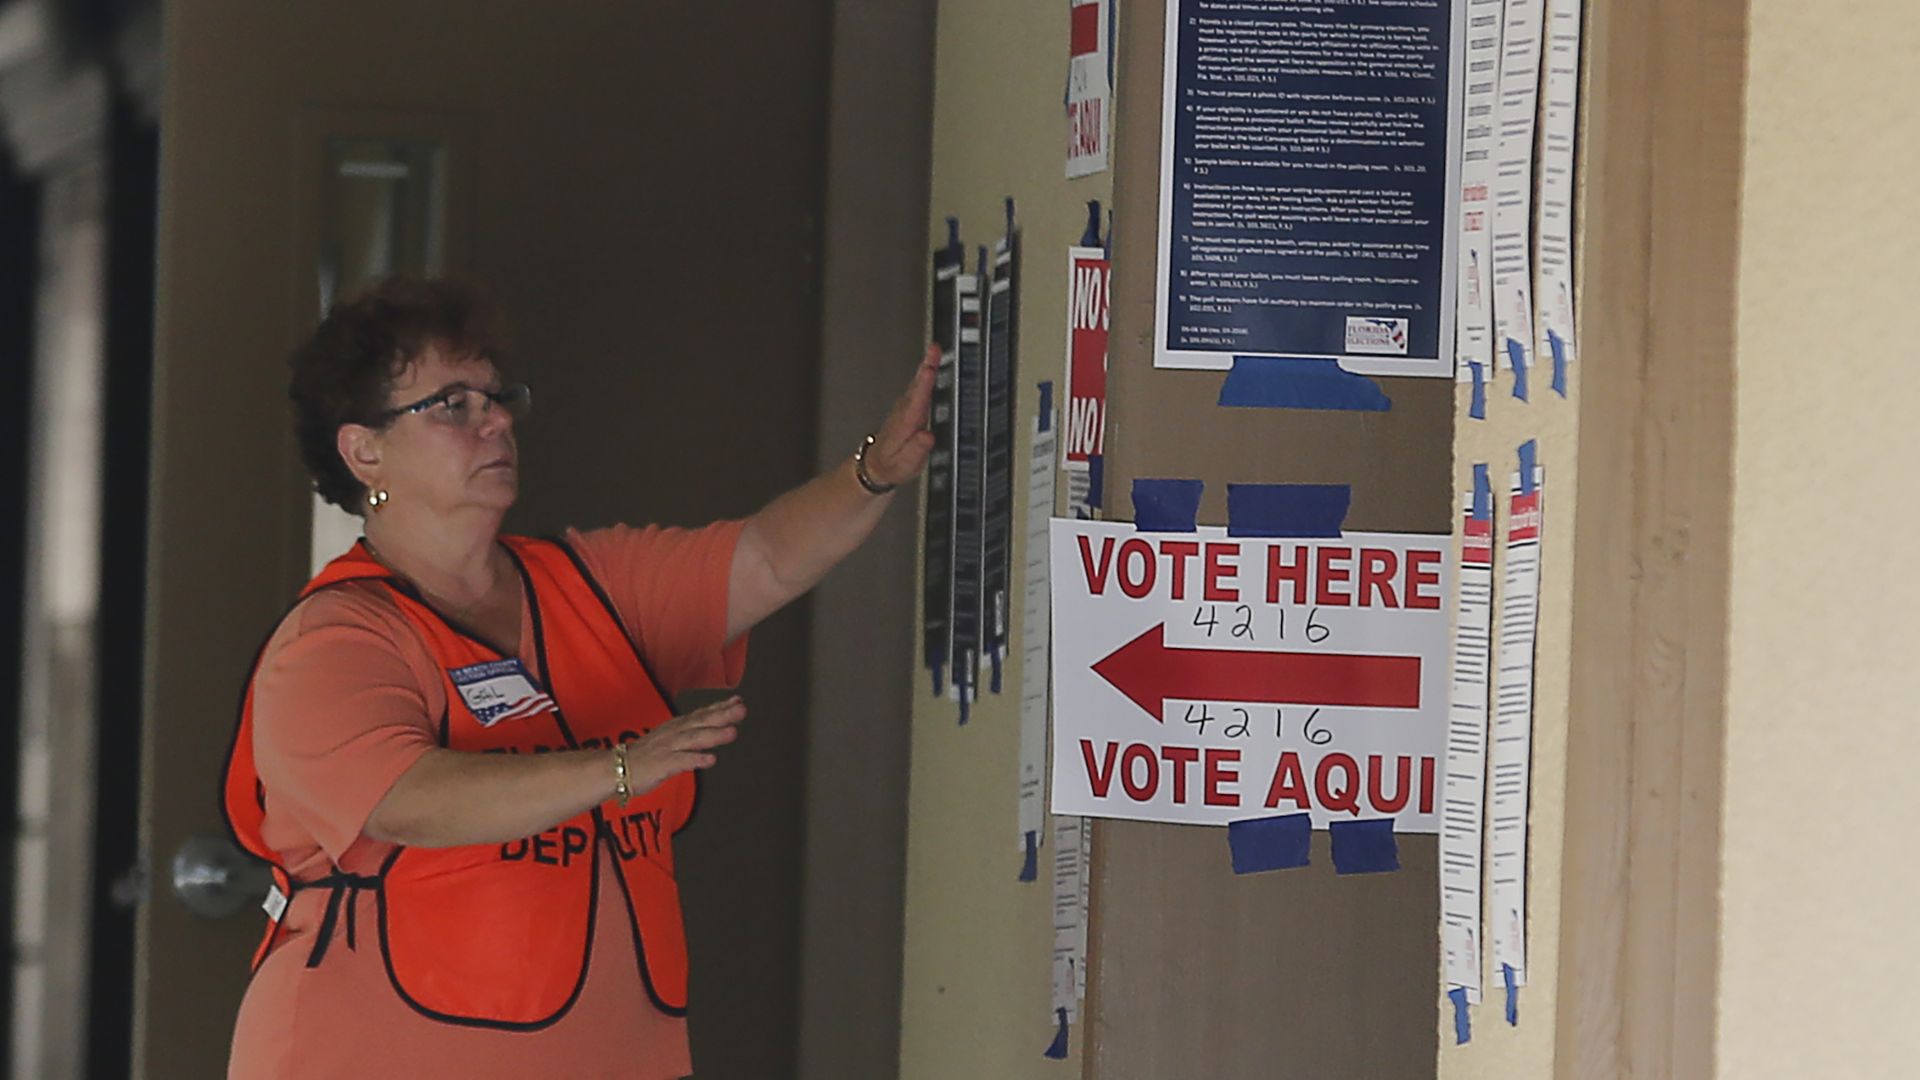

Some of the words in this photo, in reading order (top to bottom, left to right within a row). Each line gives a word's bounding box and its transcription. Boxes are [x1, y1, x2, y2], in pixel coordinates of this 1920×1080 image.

[1074, 267, 1102, 330] NO
[1069, 397, 1098, 455] NO
[1078, 535, 1241, 602] VOTE
[1266, 545, 1441, 610] HERE
[1080, 739, 1242, 807] VOTE
[1265, 752, 1436, 817] AQUI
